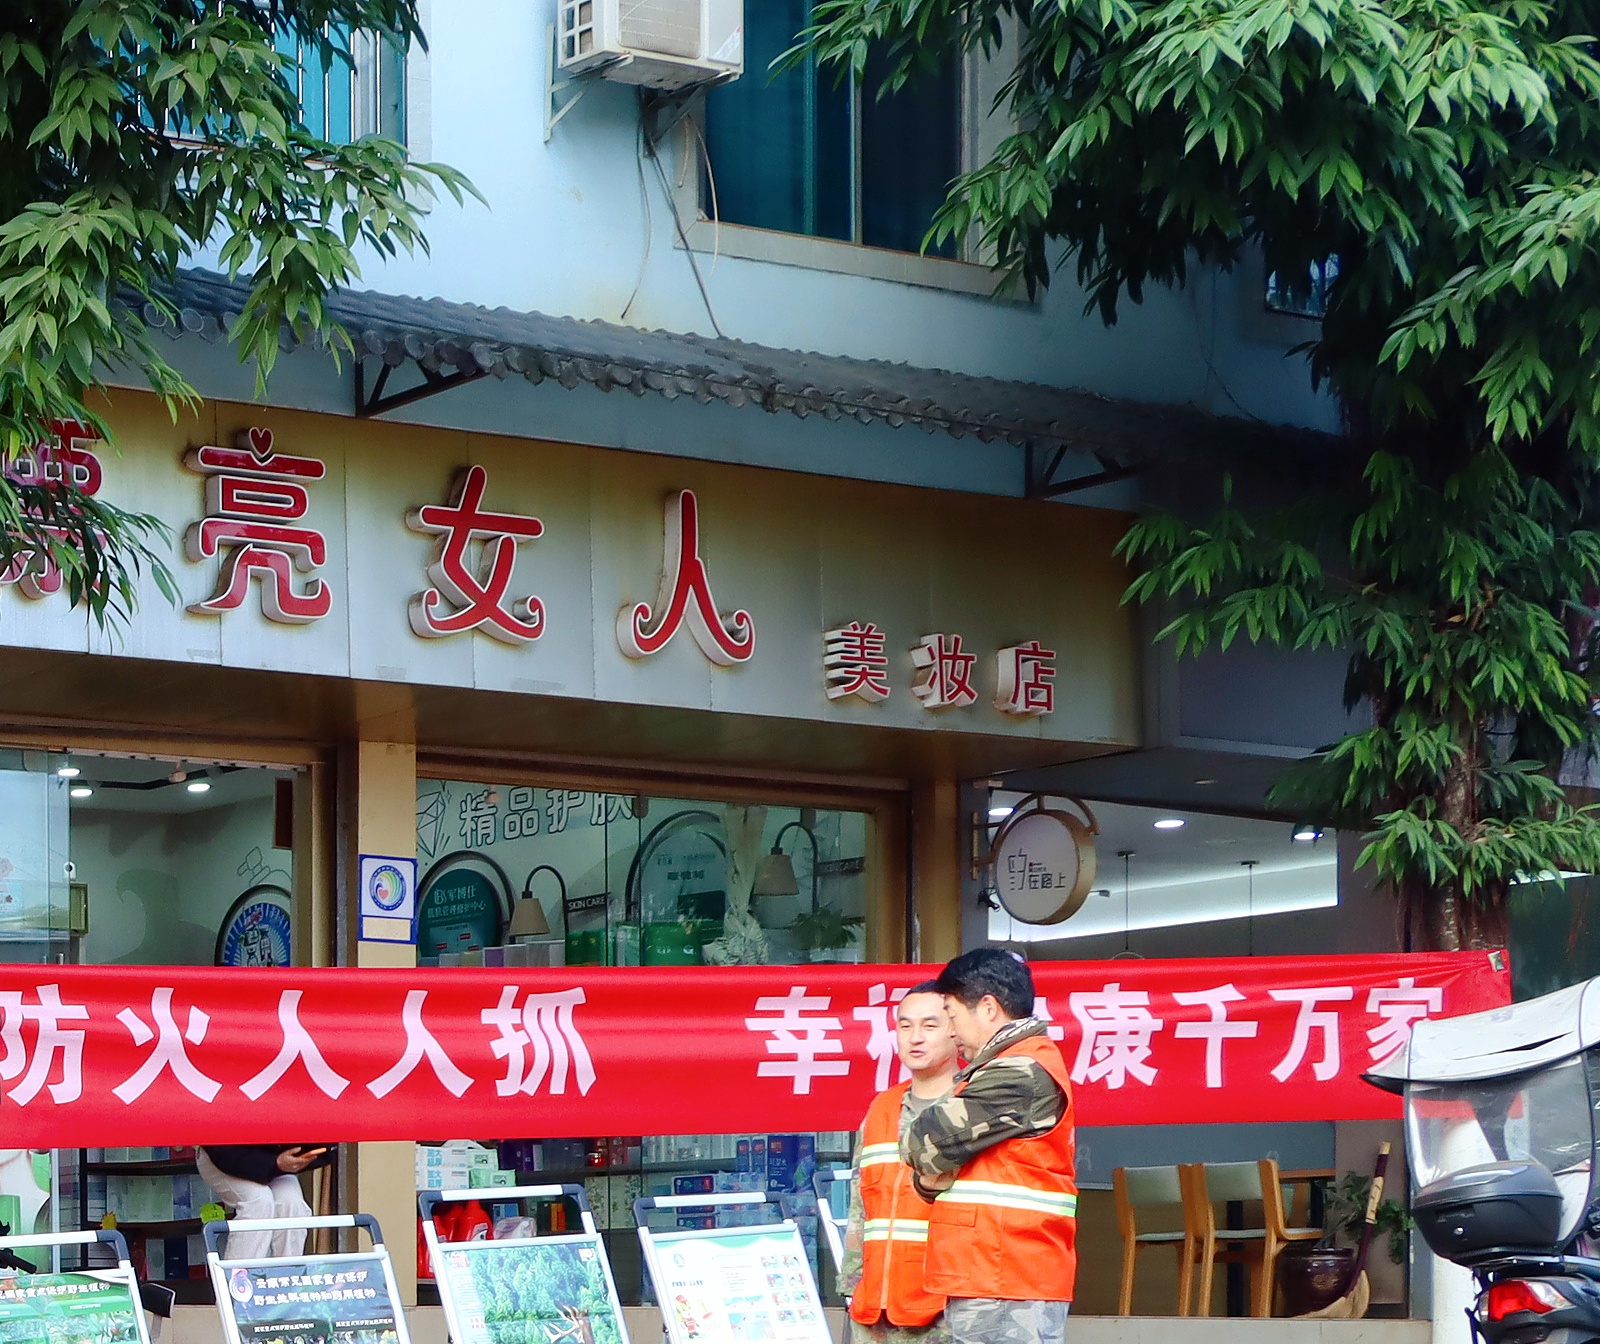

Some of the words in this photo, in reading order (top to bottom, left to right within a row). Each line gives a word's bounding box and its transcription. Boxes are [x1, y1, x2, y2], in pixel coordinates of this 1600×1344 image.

[823, 621, 1057, 715] 美妆店
[744, 975, 1444, 1095] 幸康千万家
